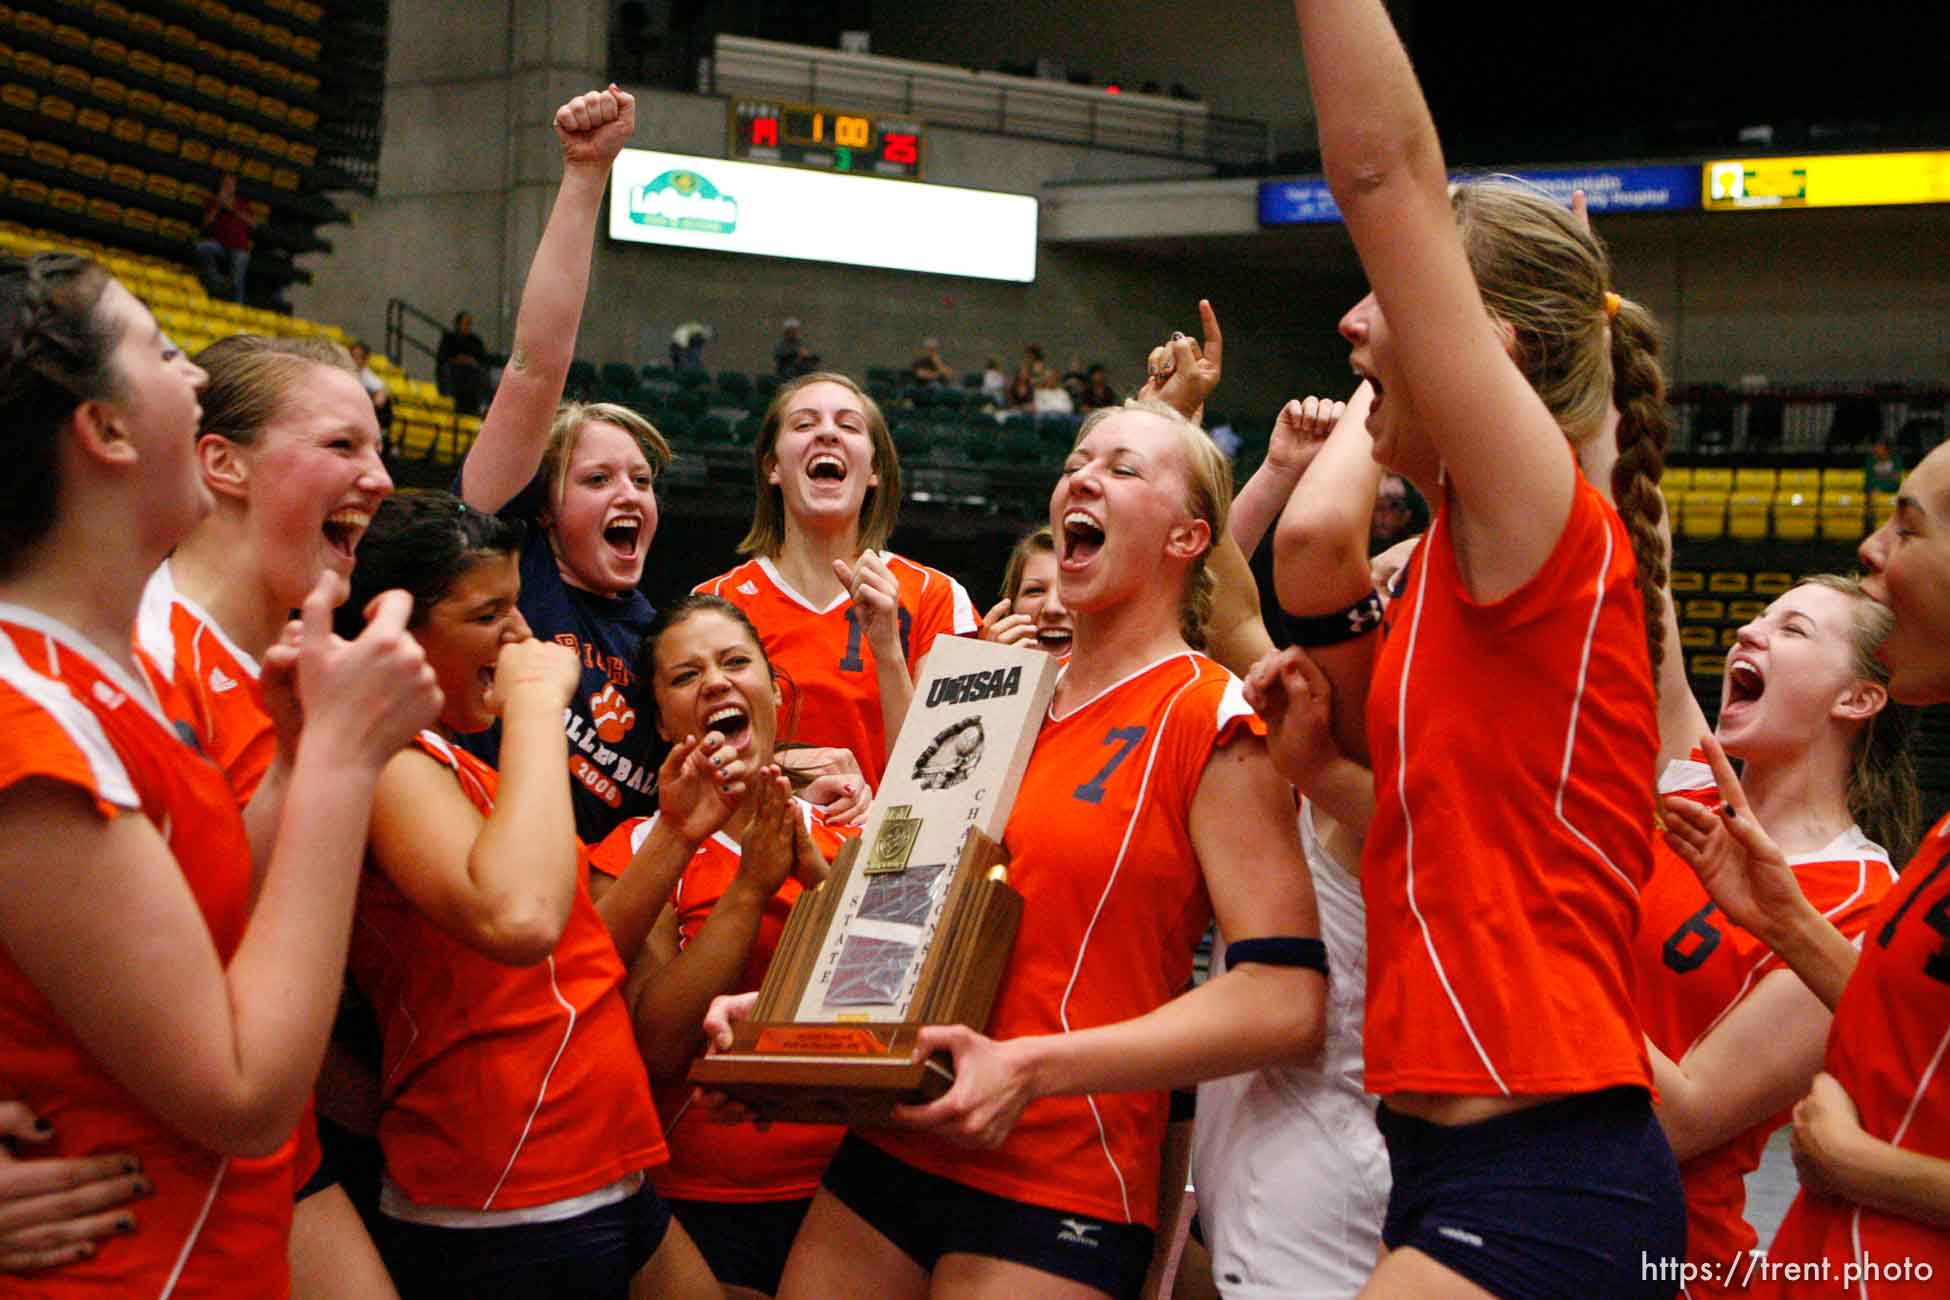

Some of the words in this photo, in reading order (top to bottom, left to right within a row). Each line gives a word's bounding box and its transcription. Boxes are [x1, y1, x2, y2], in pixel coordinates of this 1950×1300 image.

[926, 665, 1022, 709] UHSAA
[1072, 726, 1147, 804] 7
[821, 896, 859, 984] STATE
[1663, 901, 1721, 974] 6
